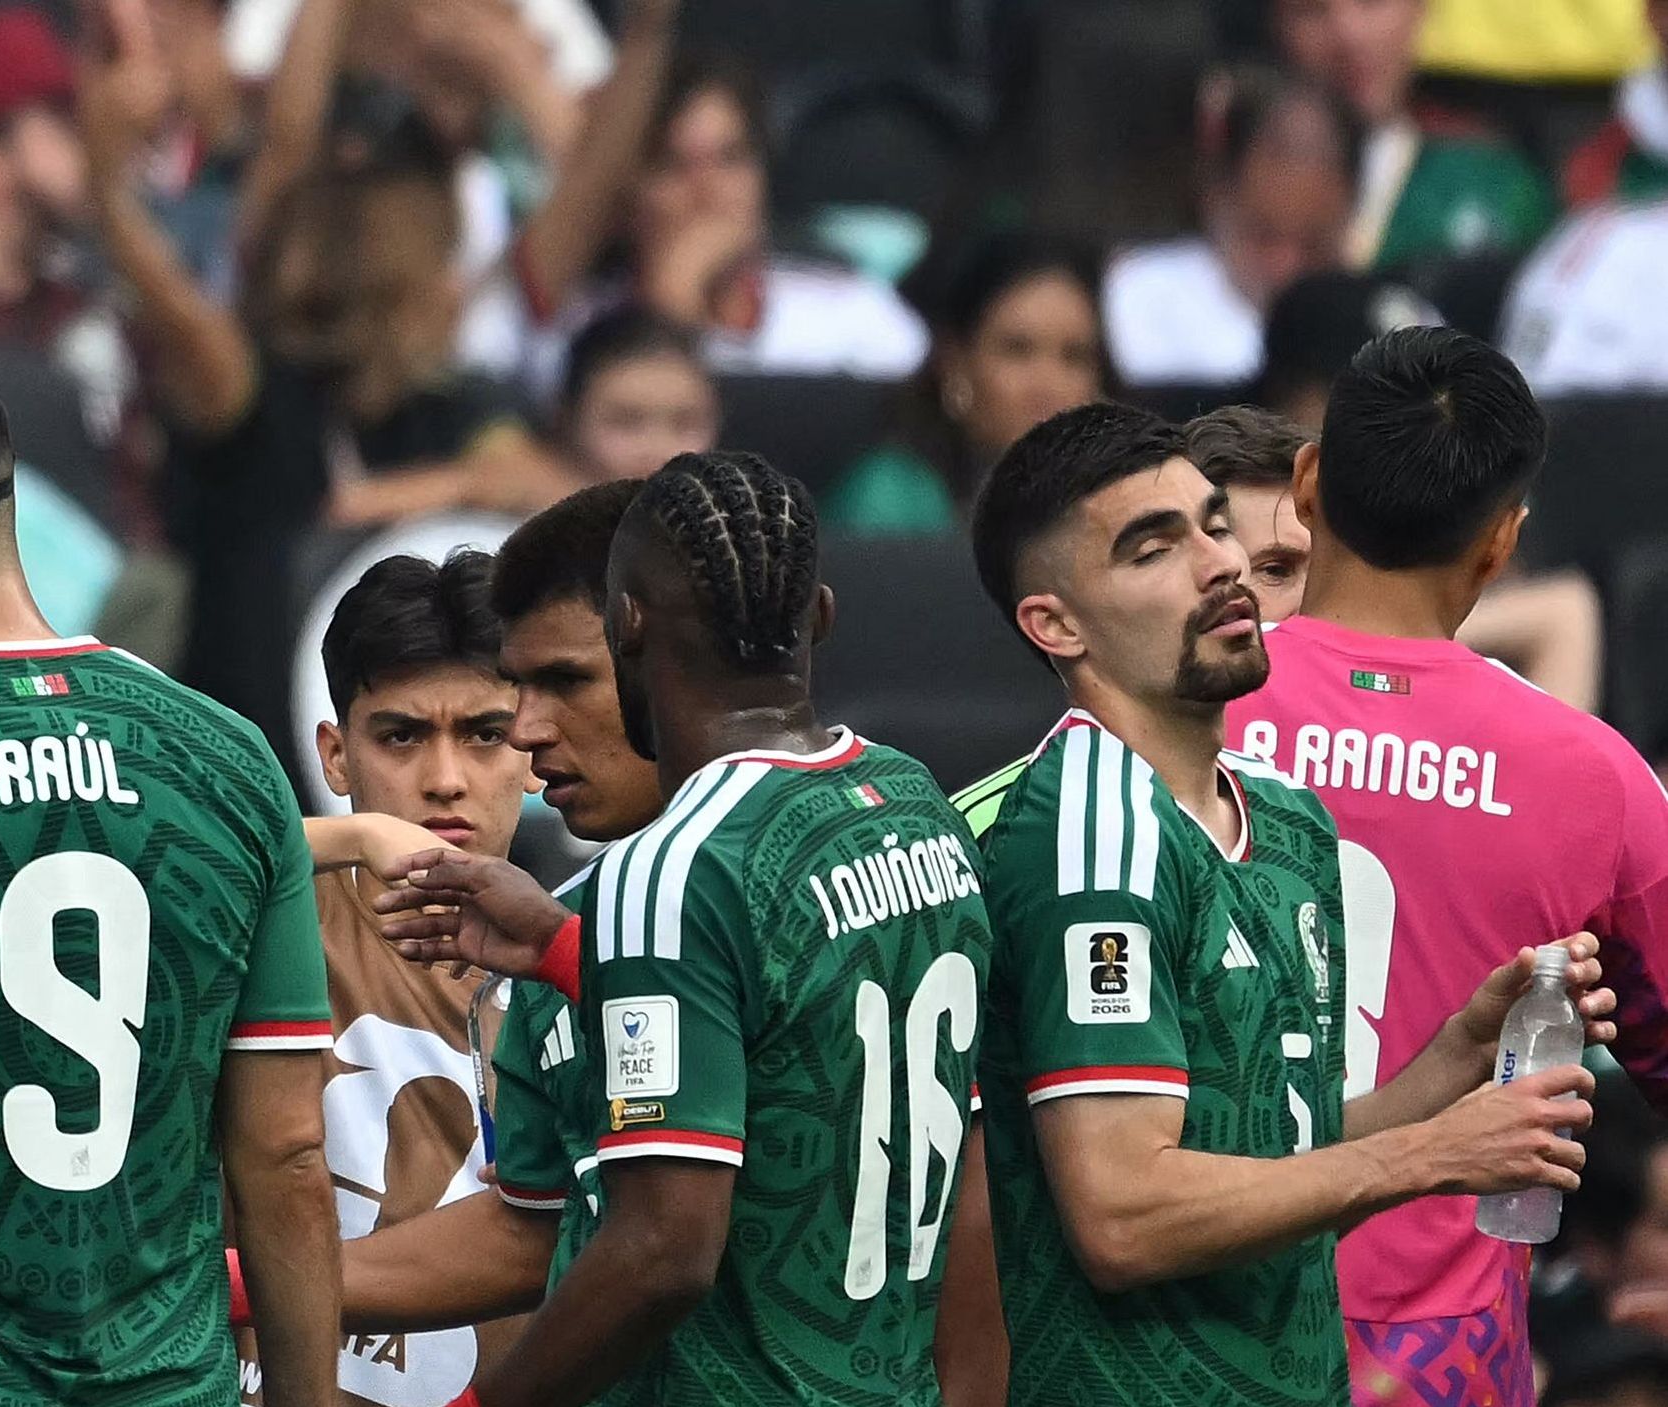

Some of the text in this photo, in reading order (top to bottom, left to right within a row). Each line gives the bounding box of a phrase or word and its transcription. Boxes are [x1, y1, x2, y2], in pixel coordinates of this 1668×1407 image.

[1091, 1005, 1131, 1015] 2026
[619, 1058, 654, 1077] PEACE
[625, 1077, 646, 1086] FIFA
[844, 951, 978, 1301] 16
